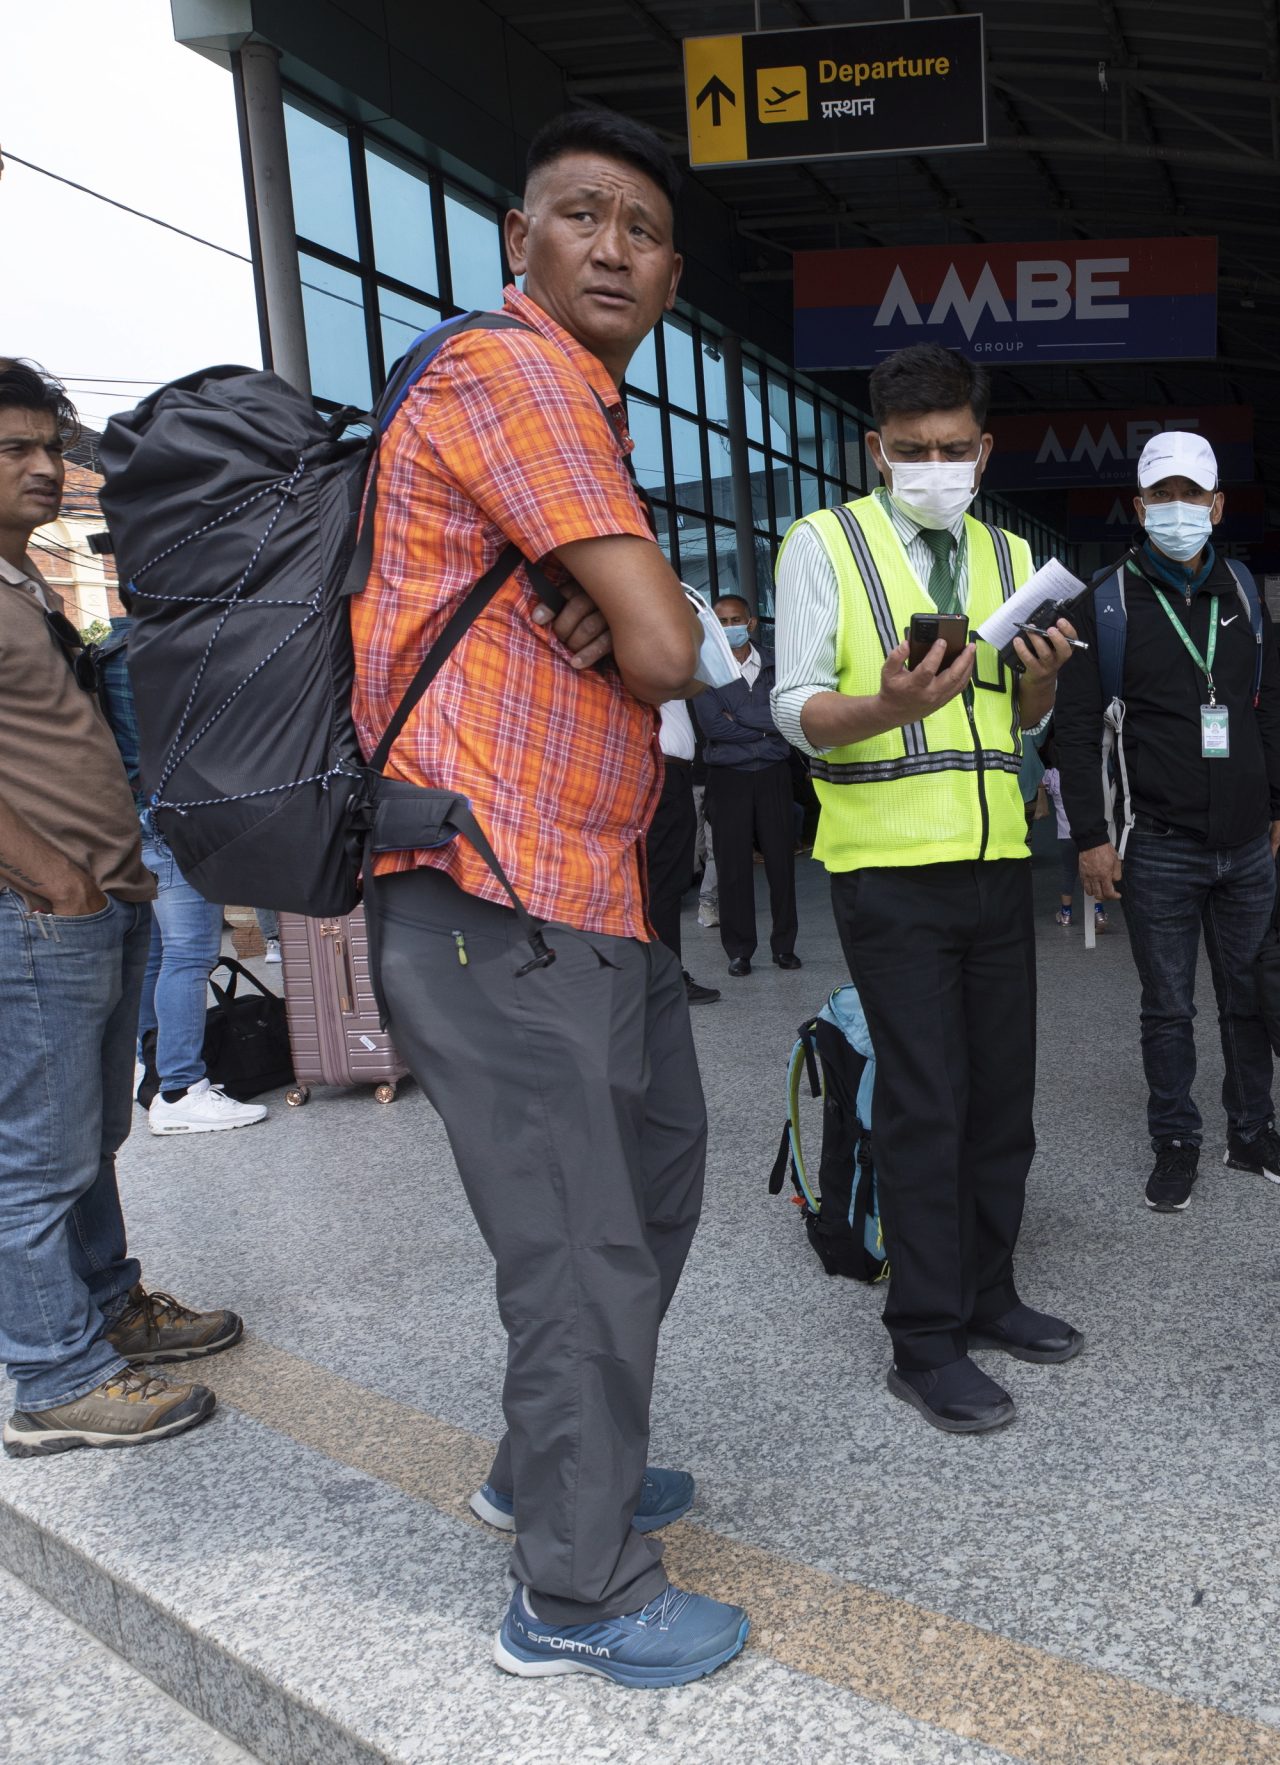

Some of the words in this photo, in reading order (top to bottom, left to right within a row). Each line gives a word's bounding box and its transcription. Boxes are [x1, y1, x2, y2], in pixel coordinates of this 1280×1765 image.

[818, 56, 950, 87] Departure
[820, 98, 875, 120] प्रस्थान
[872, 257, 1130, 342] AMBE
[973, 341, 1025, 353] GROUP
[526, 1630, 611, 1659] SPORTIVA
